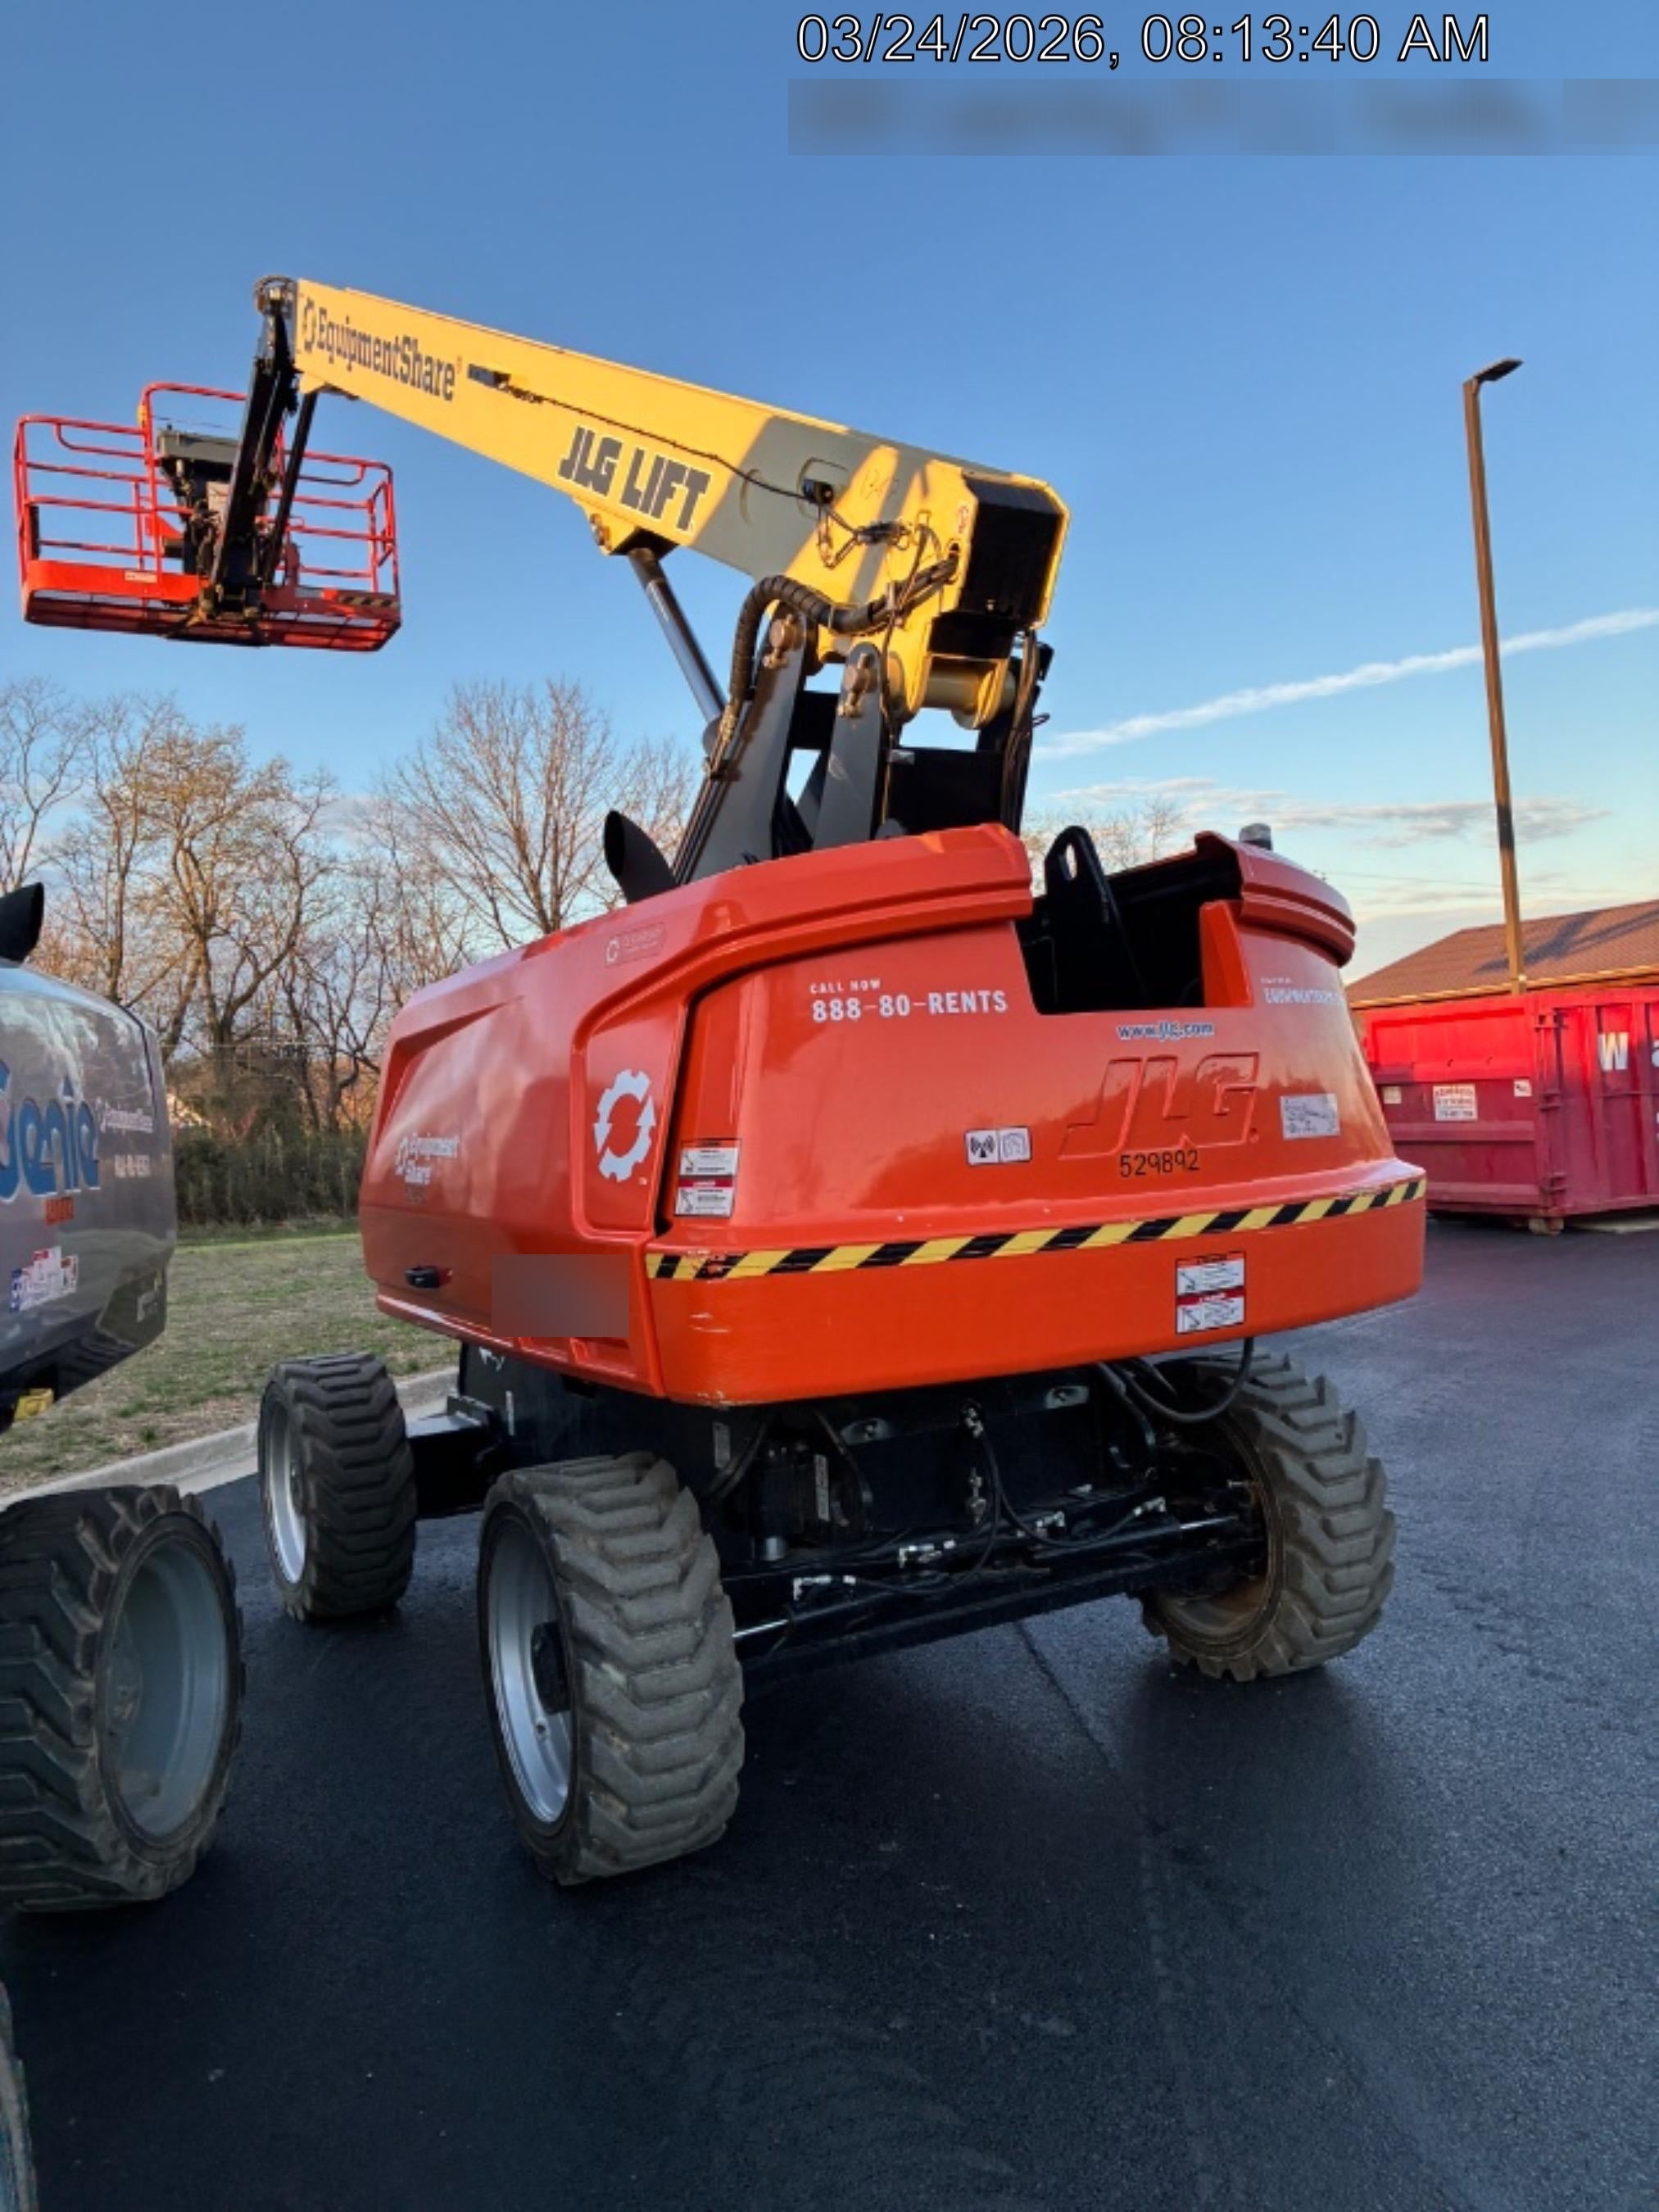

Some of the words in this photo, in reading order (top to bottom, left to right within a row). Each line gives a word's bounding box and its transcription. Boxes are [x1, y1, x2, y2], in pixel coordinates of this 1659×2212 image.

[558, 425, 623, 497] JLG
[620, 447, 713, 533] LIFT
[810, 982, 844, 995] CALL
[850, 978, 882, 991] NOW
[812, 990, 1009, 1022] 888-80-RENTS
[1117, 1022, 1214, 1041] www.jlg.com
[1120, 1149, 1199, 1178] 529892
